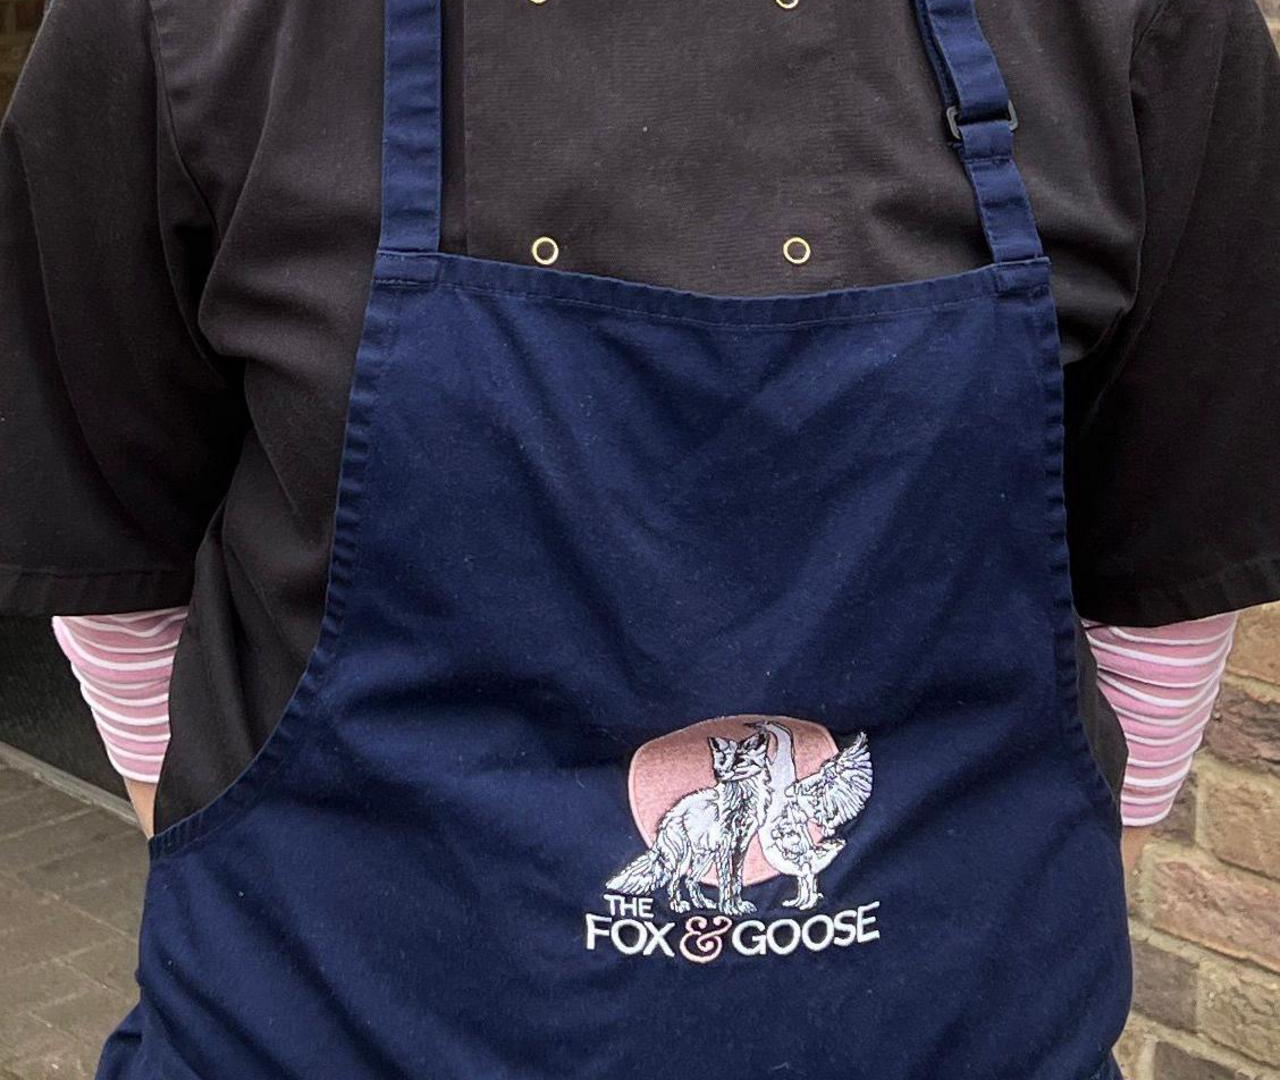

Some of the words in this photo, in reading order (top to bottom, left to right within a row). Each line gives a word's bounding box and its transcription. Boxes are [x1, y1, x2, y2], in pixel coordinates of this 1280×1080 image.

[603, 894, 655, 919] THE
[585, 913, 675, 958] FOX
[679, 916, 733, 963] &
[732, 901, 881, 956] GOOSE
